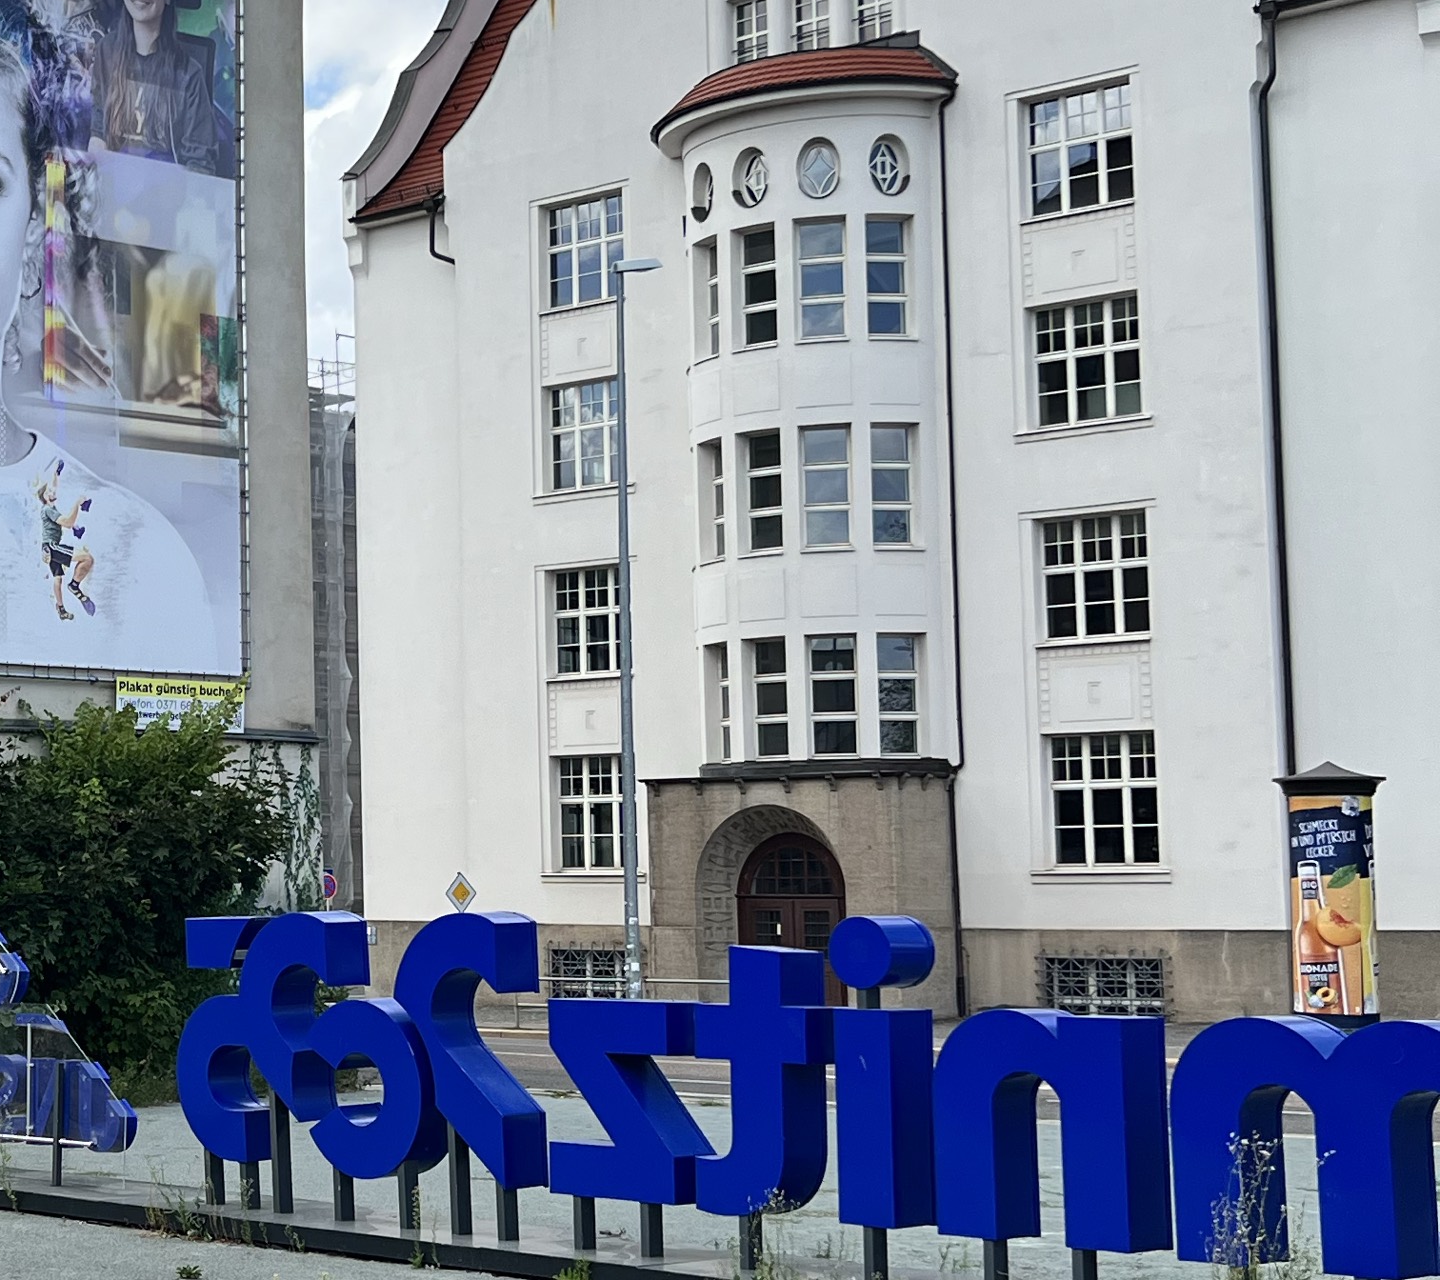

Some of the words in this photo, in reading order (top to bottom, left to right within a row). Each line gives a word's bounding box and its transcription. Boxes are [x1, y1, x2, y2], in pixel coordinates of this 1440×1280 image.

[118, 680, 153, 694] Plakat
[156, 683, 197, 698] günstig
[200, 685, 243, 698] buche?
[156, 699, 177, 710] 0371
[1298, 819, 1339, 834] SCHMECKT
[1316, 830, 1357, 845] PFIRSICH
